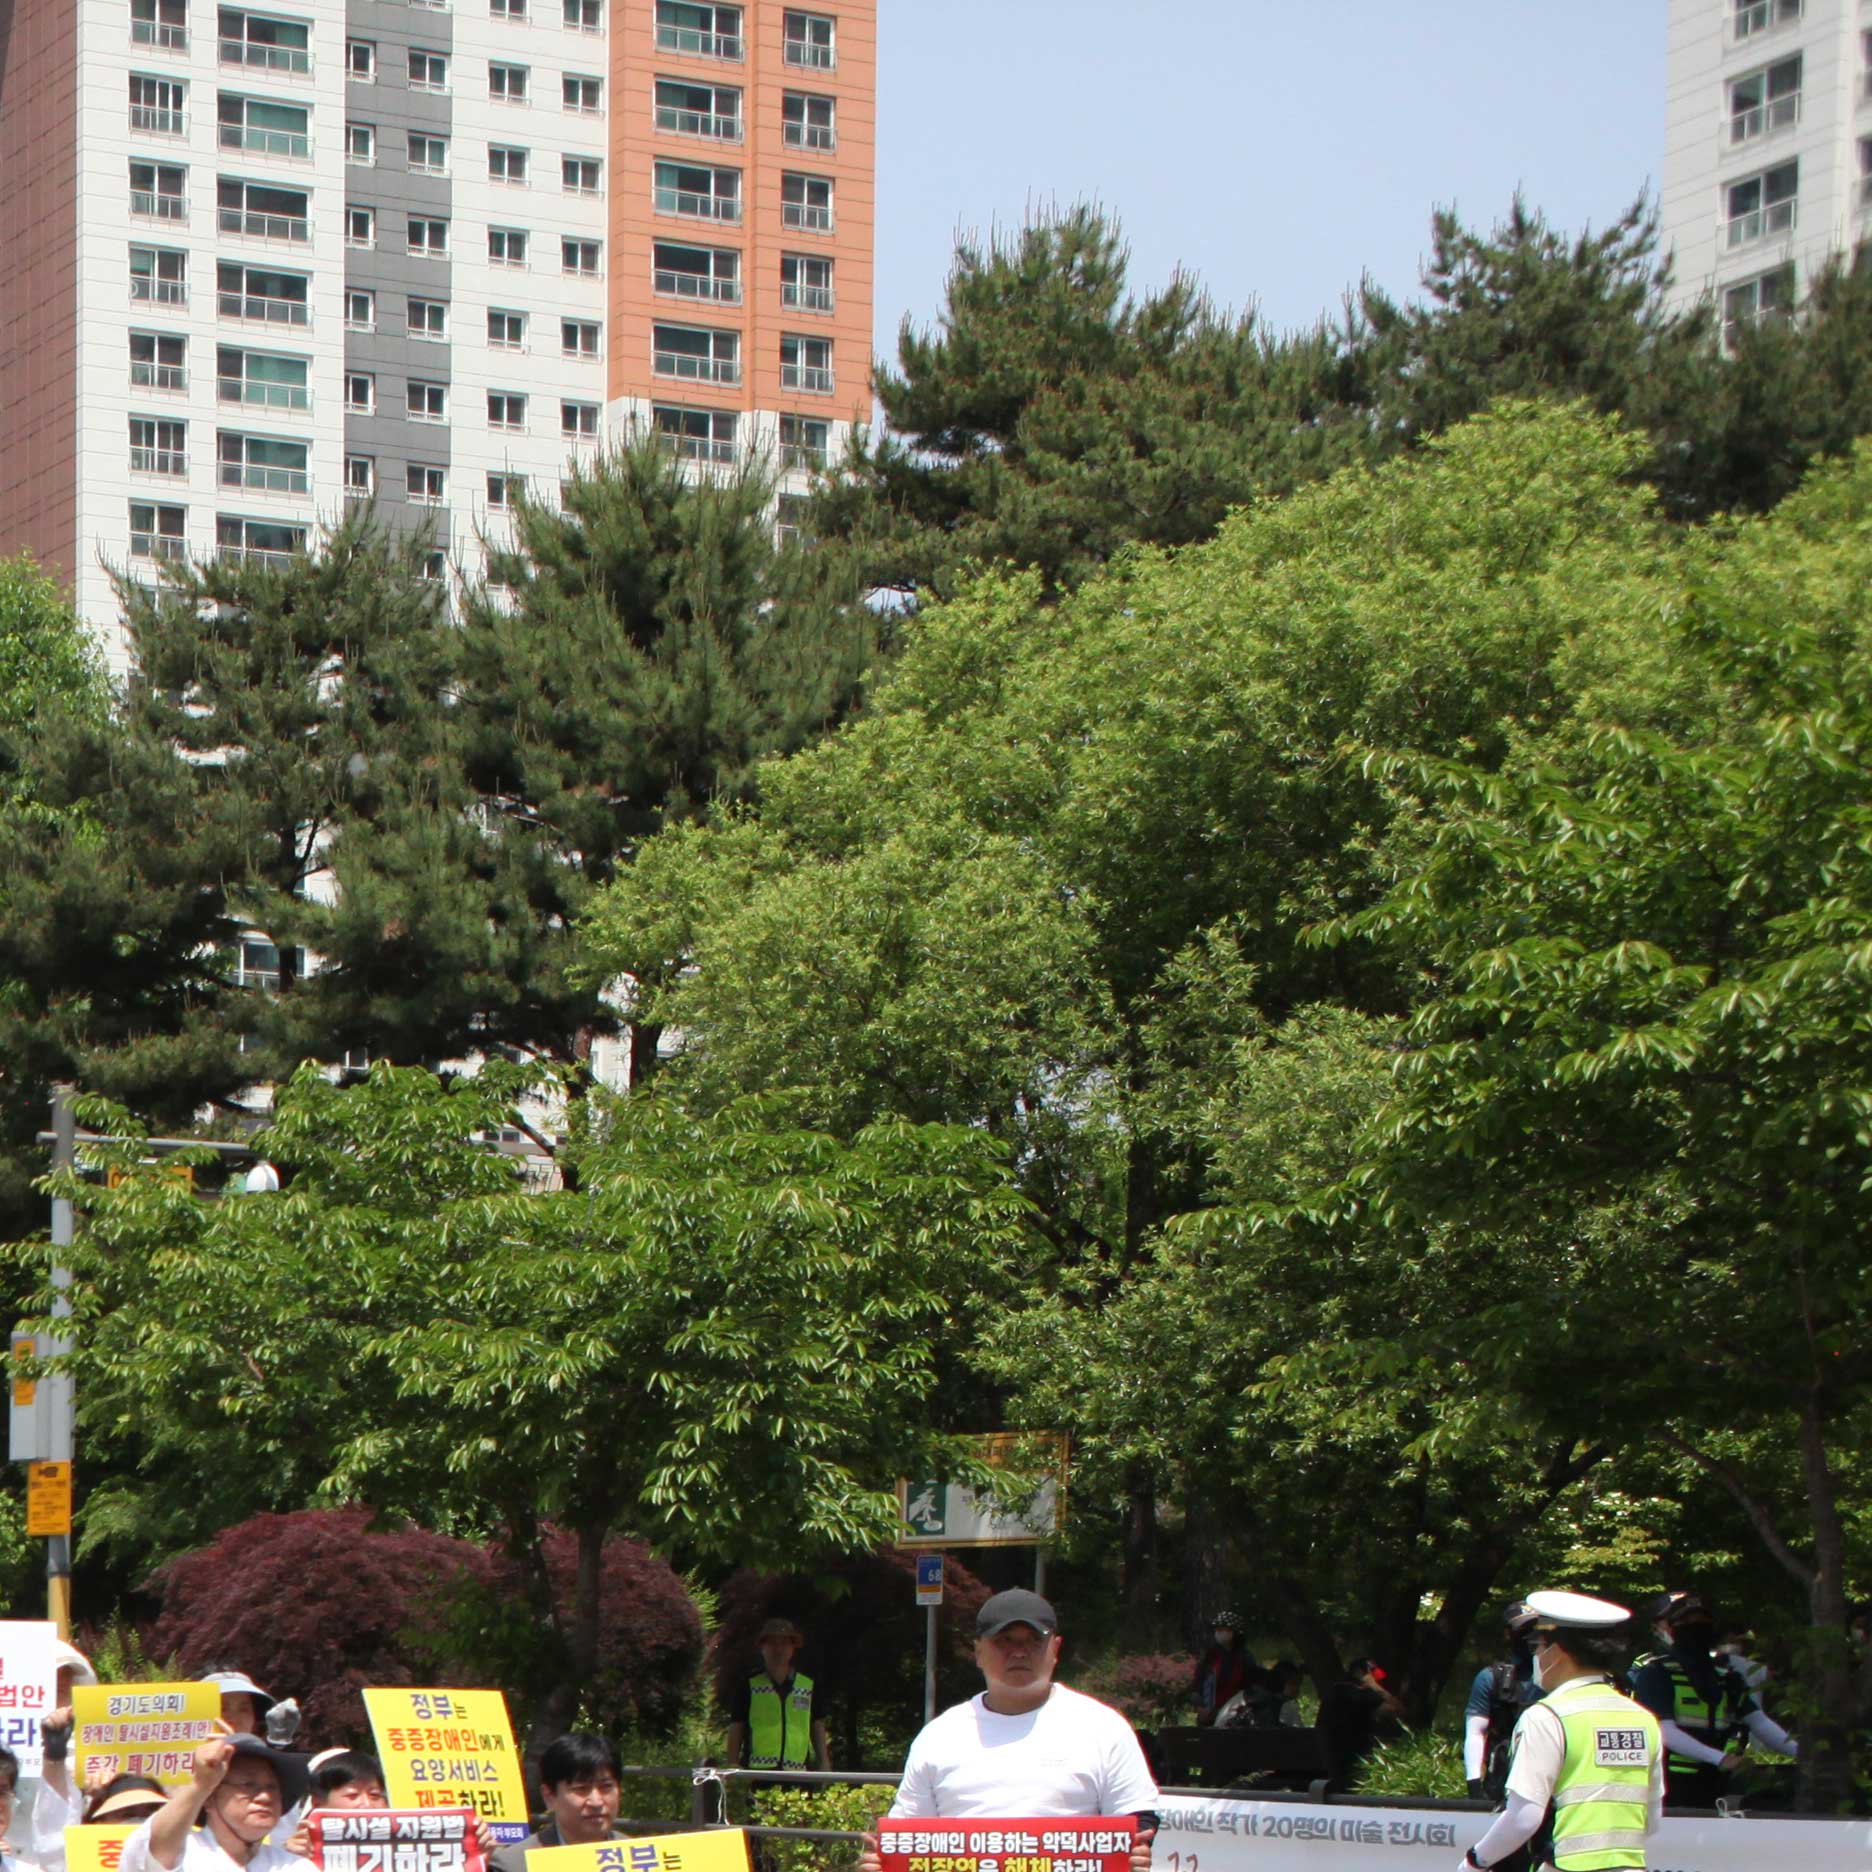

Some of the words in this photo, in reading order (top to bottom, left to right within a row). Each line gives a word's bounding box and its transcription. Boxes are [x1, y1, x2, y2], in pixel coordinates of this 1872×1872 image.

[409, 1694, 468, 1721] 정부는
[387, 1728, 506, 1753] 중증장애인에게
[1602, 1750, 1643, 1762] POLICE
[410, 1758, 500, 1782] 요양서비스
[1217, 1813, 1257, 1836] 작가
[1263, 1815, 1335, 1841] 20명의
[1341, 1820, 1383, 1844] 미술
[1388, 1822, 1456, 1847] 전시회
[880, 1832, 965, 1854] 중증장애인
[970, 1832, 1037, 1856] 이용하는
[1042, 1831, 1132, 1854] 악덕사업자
